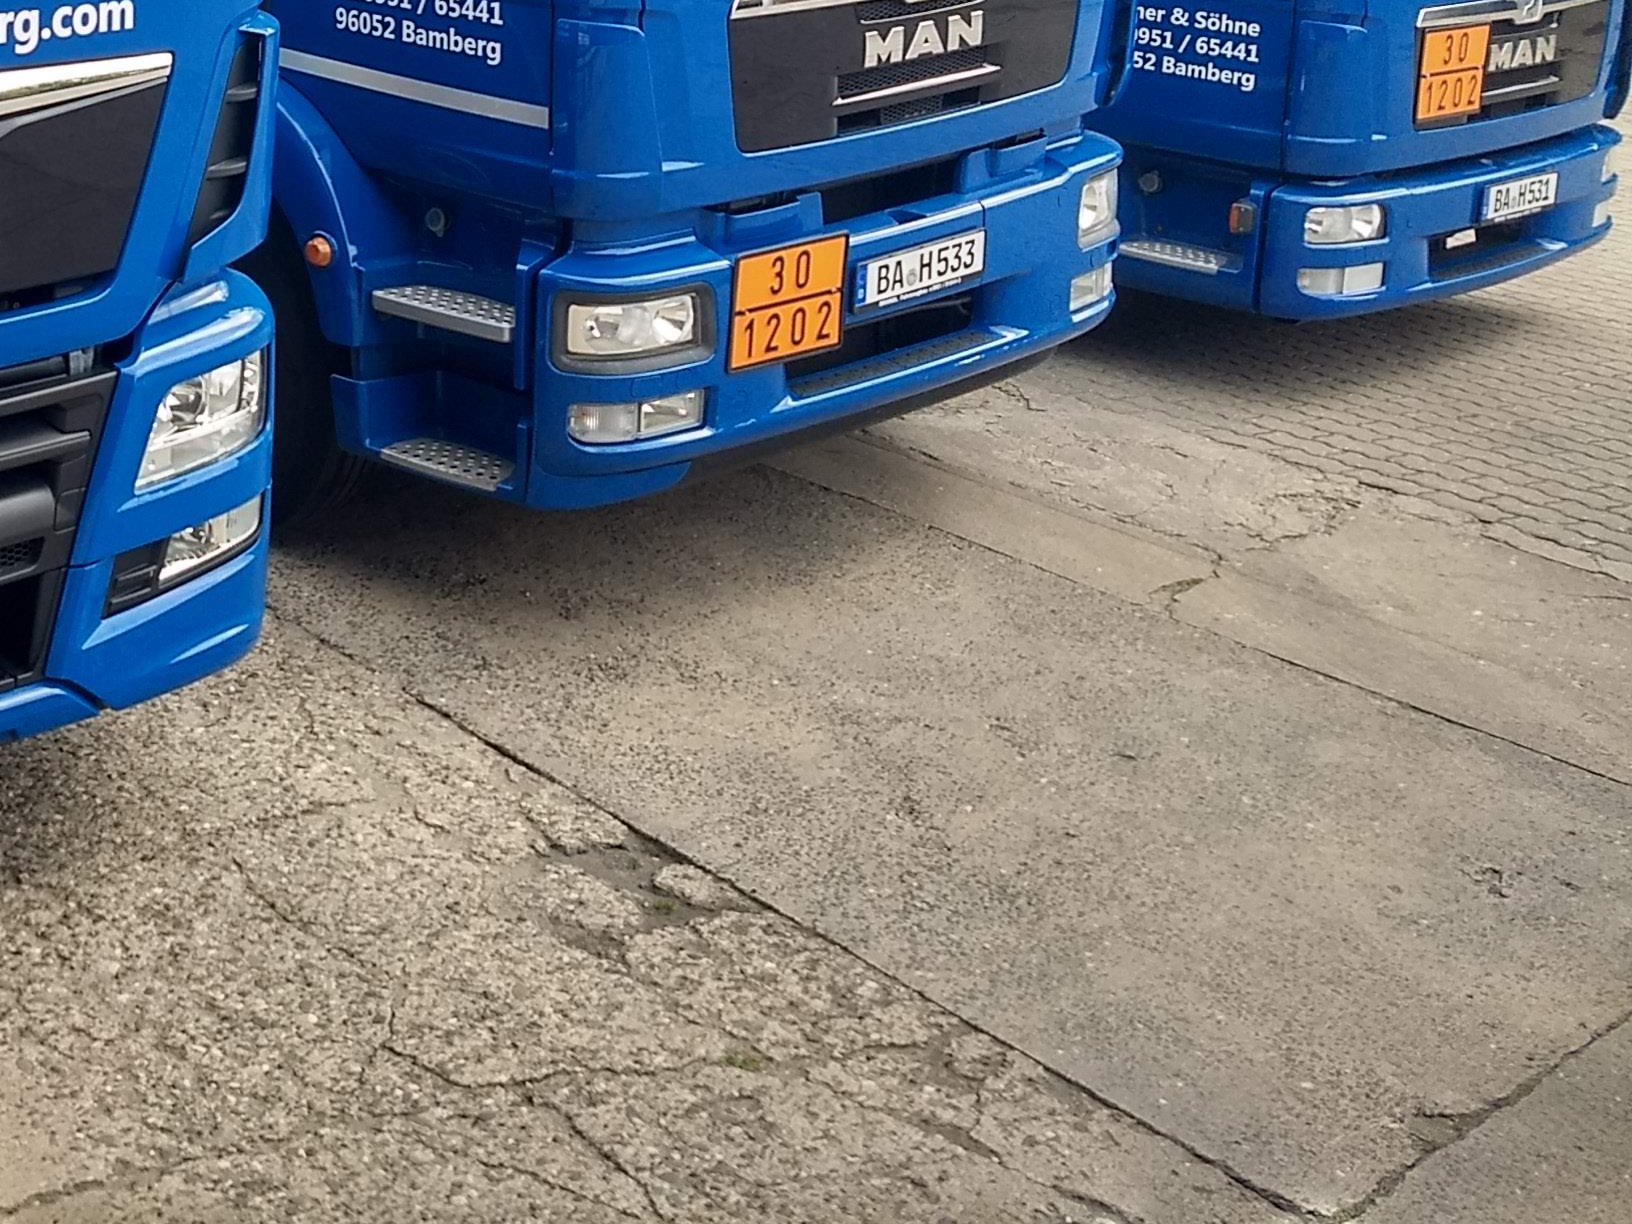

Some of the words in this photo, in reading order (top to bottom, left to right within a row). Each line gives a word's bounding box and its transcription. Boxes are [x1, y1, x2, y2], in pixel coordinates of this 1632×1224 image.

[335, 7, 396, 41] 96052
[401, 19, 502, 66] Bamberg
[863, 9, 985, 69] MAN
[1169, 7, 1190, 27] &
[1193, 10, 1261, 38] Söhne
[1134, 26, 1174, 50] 951
[1177, 34, 1192, 54] /
[1194, 36, 1260, 63] 65441
[1442, 31, 1469, 66] 30
[1486, 33, 1557, 73] MAN
[1161, 55, 1256, 92] Bamberg
[1425, 74, 1479, 114] 1202
[769, 249, 811, 296] 30
[876, 259, 905, 296] BA
[743, 299, 833, 359] 1202
